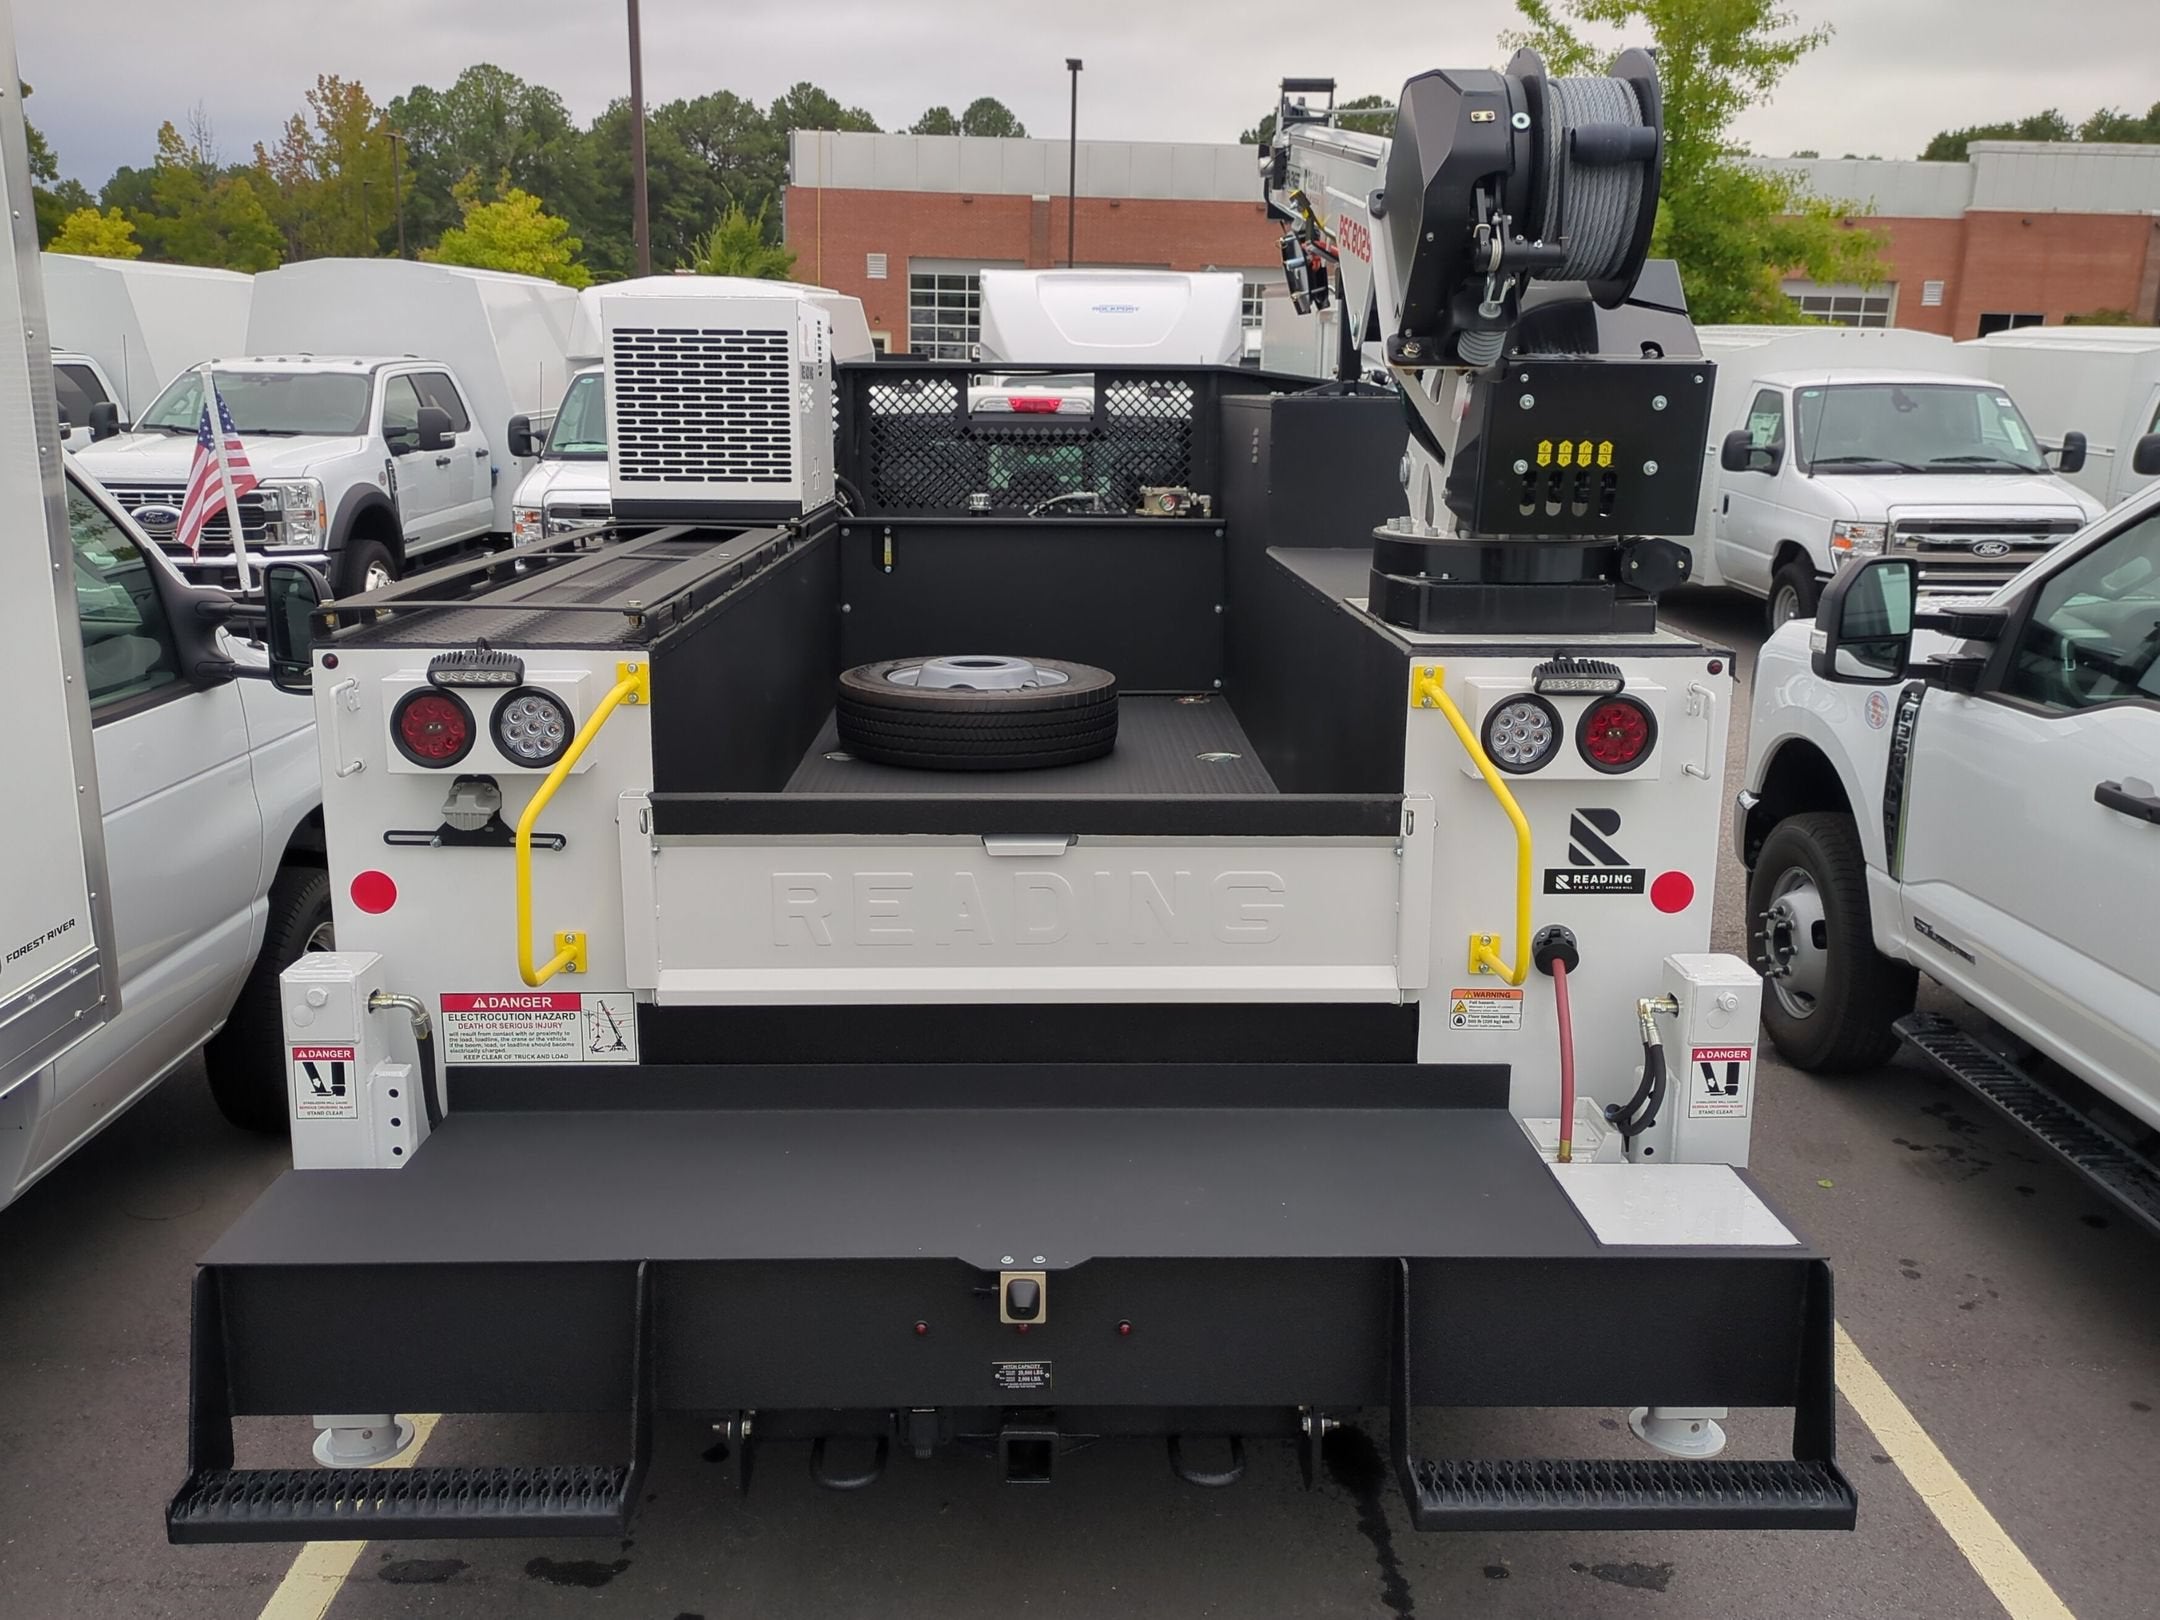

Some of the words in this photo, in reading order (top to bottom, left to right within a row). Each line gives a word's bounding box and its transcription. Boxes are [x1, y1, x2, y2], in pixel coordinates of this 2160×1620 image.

[1573, 874, 1632, 884] READING
[771, 870, 1286, 947] READING
[6, 935, 46, 963] FOREST
[46, 918, 76, 941] RIVER
[489, 996, 552, 1009] DANGER
[448, 1013, 532, 1022] ELECTROCUTION
[535, 1012, 576, 1021] HAZARD
[458, 1022, 484, 1030] DEATH
[535, 1021, 563, 1029] INJURY
[308, 1049, 351, 1058] DANGER
[1707, 1051, 1748, 1059] DANGER
